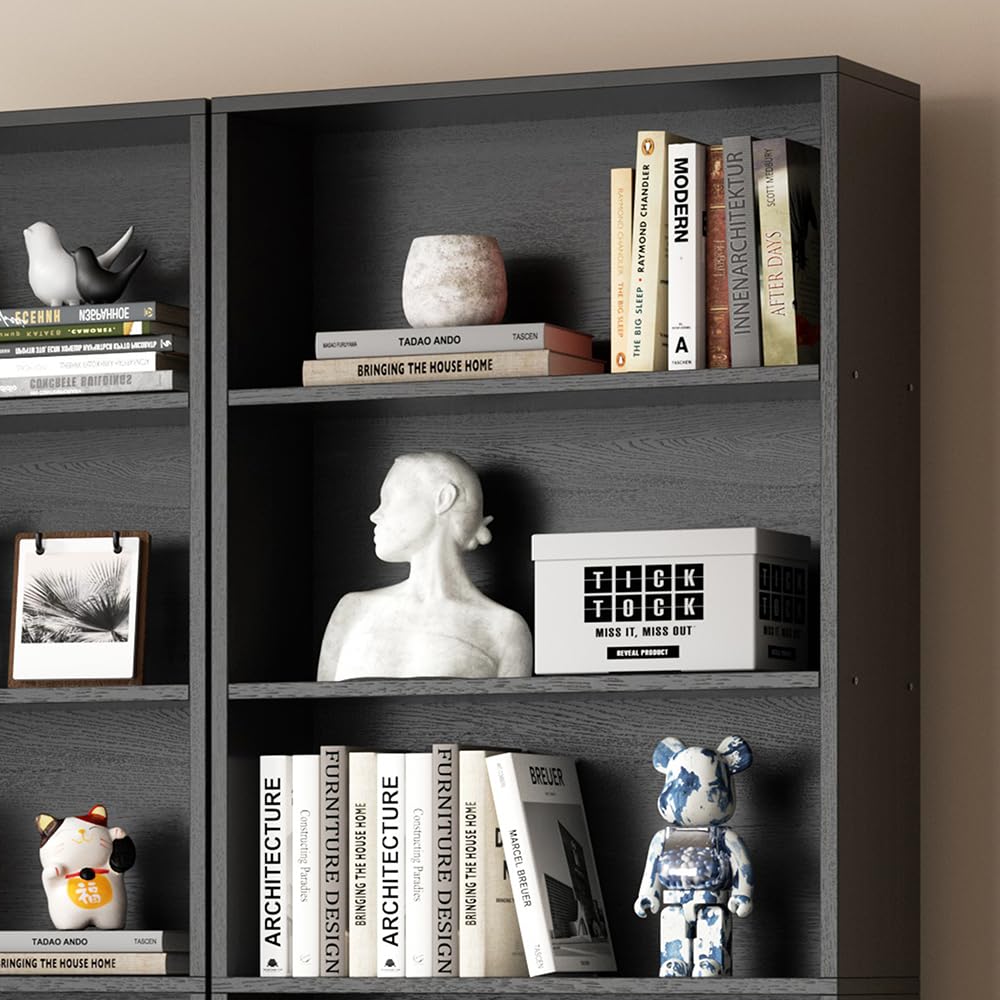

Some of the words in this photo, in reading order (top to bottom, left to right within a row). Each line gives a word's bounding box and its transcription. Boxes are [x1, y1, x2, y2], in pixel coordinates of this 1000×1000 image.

[763, 148, 774, 184] MEDBURY
[640, 164, 650, 217] CHANDLER
[674, 157, 689, 243] MODERN
[766, 185, 776, 207] SCOTT
[638, 222, 648, 273] RAYMOND
[727, 151, 751, 335] INNENARCHITEKTUR
[765, 230, 784, 270] DAYS
[617, 282, 625, 298] THE
[636, 286, 644, 314] SLEEP
[767, 270, 786, 316] AFTER
[617, 300, 625, 314] BIG
[398, 336, 431, 346] TADAO
[433, 335, 461, 345] ANDO
[617, 315, 625, 338] SLEEP
[634, 318, 642, 336] BIG
[633, 340, 641, 357] THE
[675, 336, 689, 353] A
[357, 360, 405, 377] BRINGING
[408, 360, 427, 374] THE
[429, 359, 462, 374] HOUSE
[465, 357, 493, 372] HOME
[593, 568, 695, 589] TICK
[593, 597, 695, 618] TOCK
[595, 628, 621, 639] MISS
[625, 627, 638, 639] IT,
[642, 626, 668, 637] MISS
[673, 626, 692, 636] OUT
[616, 649, 640, 657] REVEAL
[640, 648, 669, 656] PRODUCT
[529, 766, 565, 787] BREUER
[325, 751, 340, 884] FURNITURE
[355, 802, 366, 828] HOME
[438, 749, 453, 883] FURNITURE
[465, 801, 477, 827] HOME
[298, 809, 311, 864] Constructing
[355, 830, 366, 860] HOUSE
[410, 808, 424, 864] Constructing
[465, 829, 477, 859] HOUSE
[264, 778, 281, 947] ARCHITECTURE
[355, 862, 366, 880] THE
[382, 776, 399, 947] ARCHITECTURE
[465, 862, 477, 879] THE
[509, 829, 523, 868] MARCEL
[517, 869, 532, 908] BREUER
[298, 867, 311, 903] Paradies
[410, 867, 424, 903] Paradies
[355, 882, 366, 926] BRINGING
[465, 881, 477, 926] BRINGING
[32, 938, 61, 946] TADAO
[63, 938, 88, 946] ANDO
[325, 890, 340, 974] DESIGN
[438, 890, 453, 974] DESIGN
[40, 959, 57, 968] THE
[59, 959, 88, 968] HOUSE
[91, 958, 116, 968] HOME
